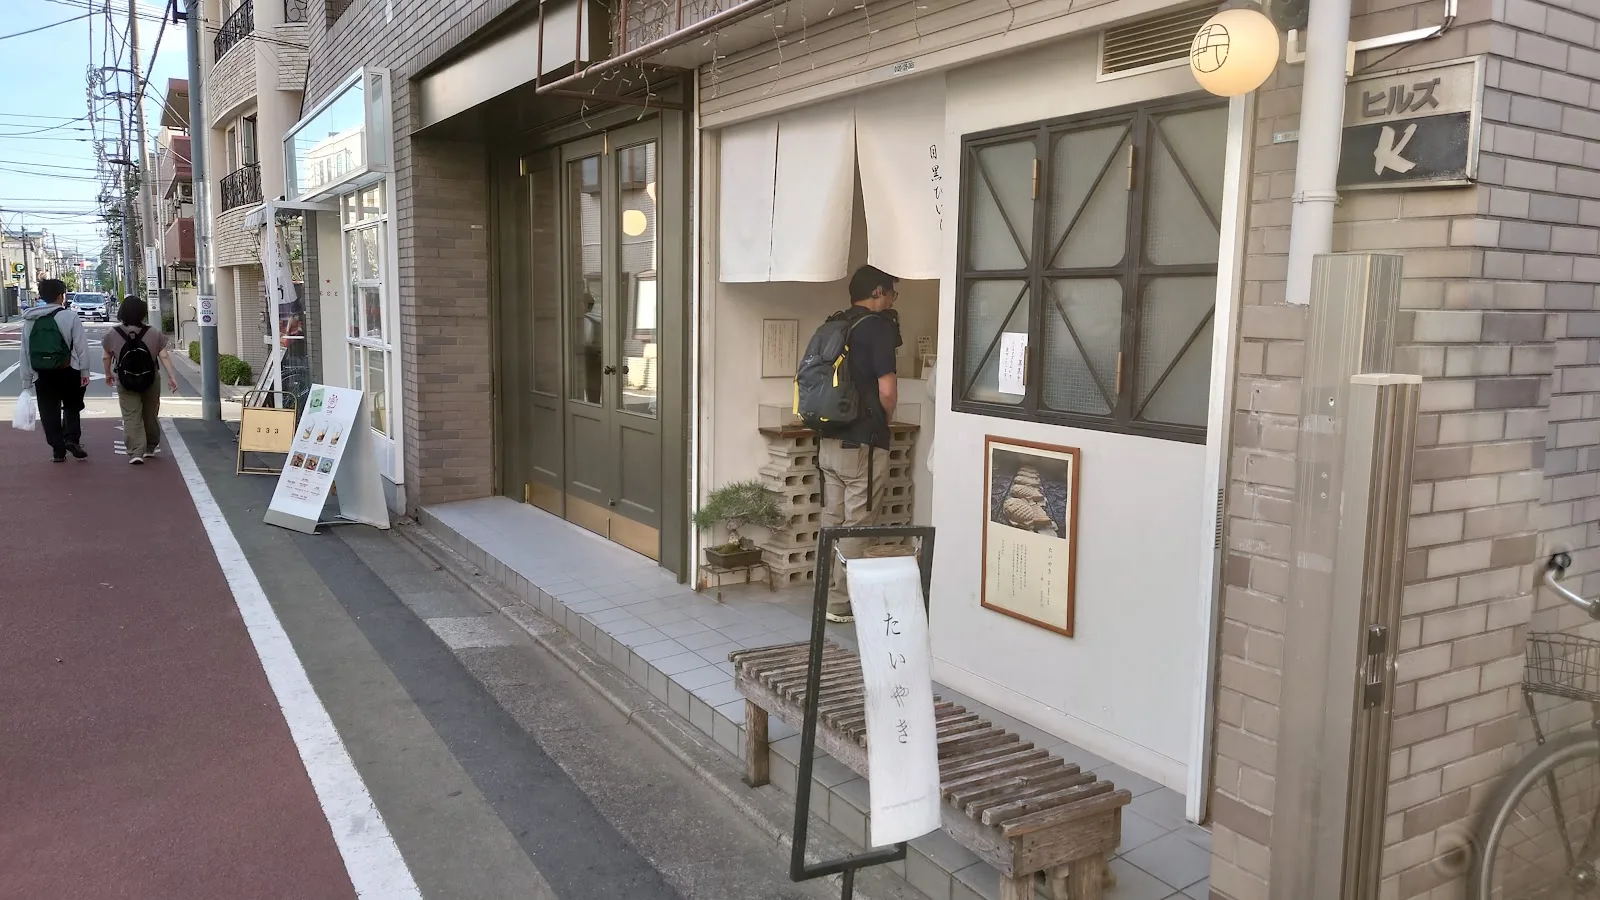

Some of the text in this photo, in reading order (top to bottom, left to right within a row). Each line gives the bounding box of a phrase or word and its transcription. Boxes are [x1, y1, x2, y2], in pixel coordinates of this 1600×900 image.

[1362, 77, 1441, 118] ヒルズ
[1373, 123, 1417, 176] K
[882, 612, 910, 745] たいやき
